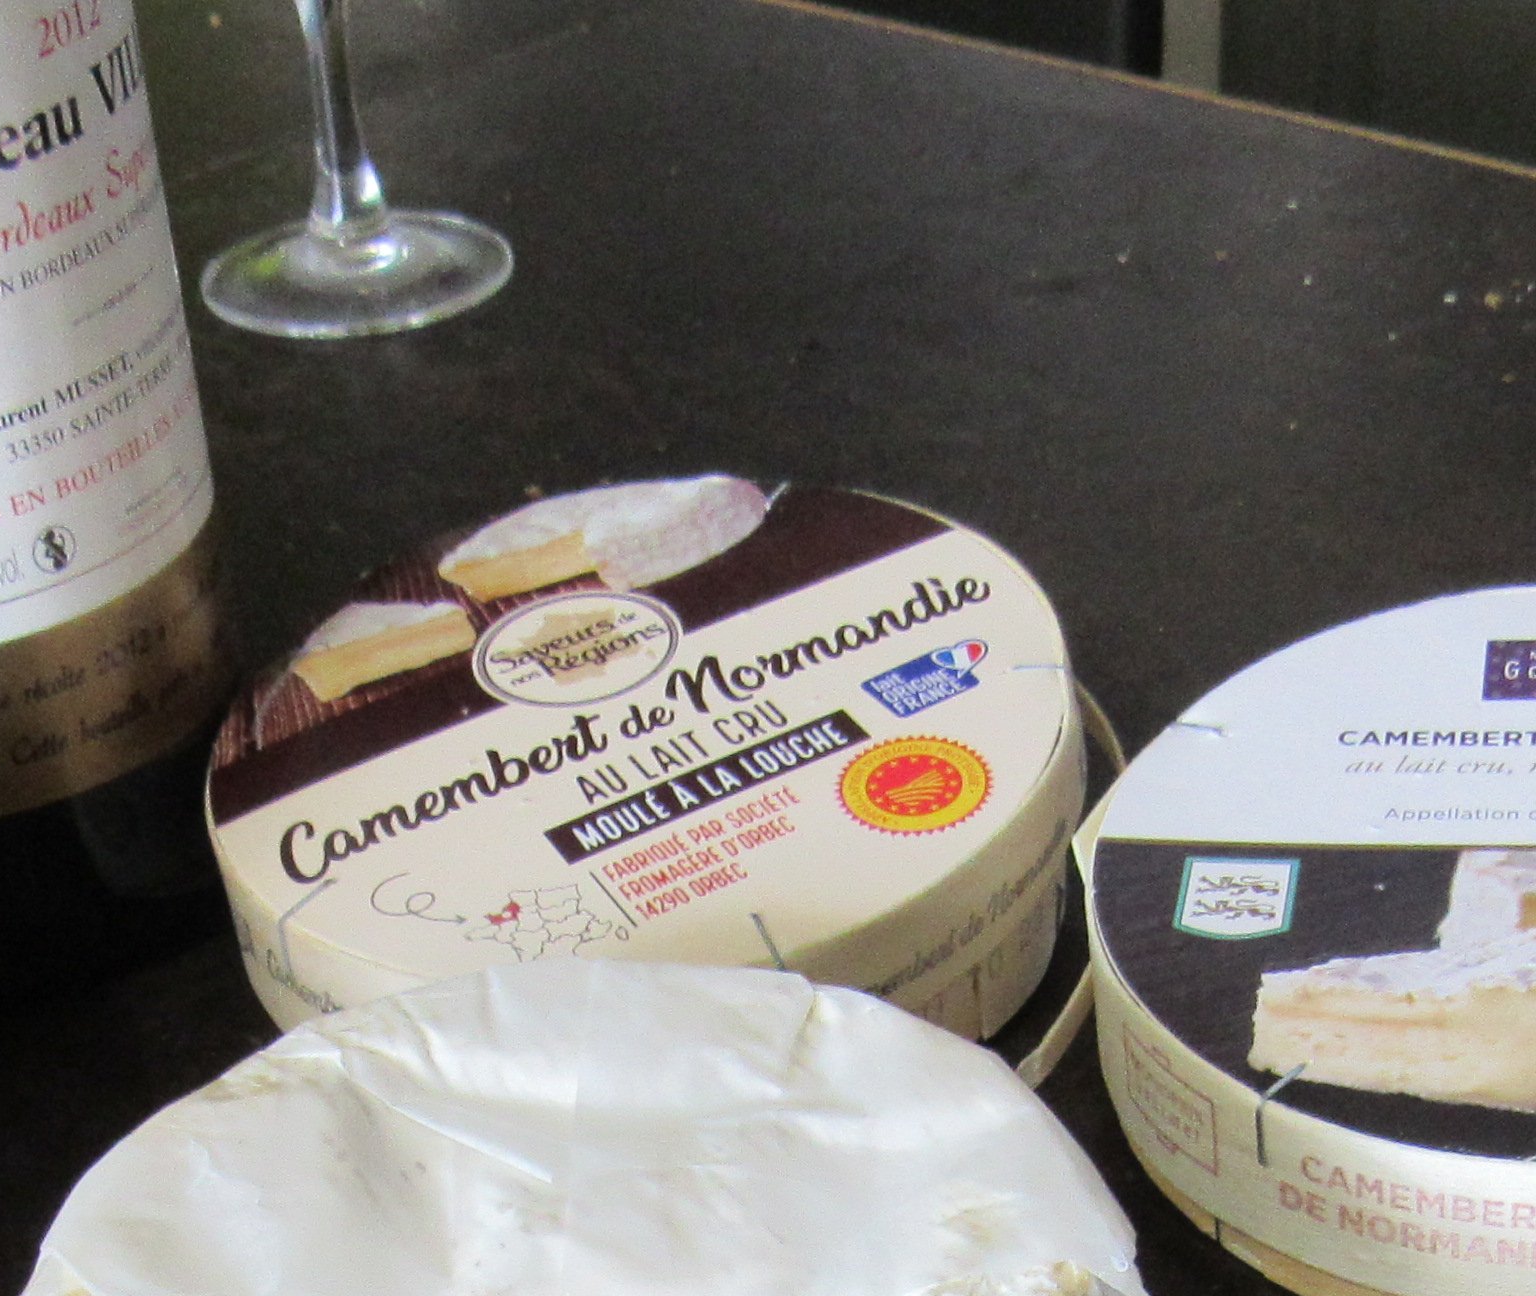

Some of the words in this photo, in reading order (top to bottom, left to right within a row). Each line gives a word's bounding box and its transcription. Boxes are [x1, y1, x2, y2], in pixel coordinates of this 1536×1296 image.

[6, 428, 64, 464] 33350
[9, 486, 46, 517] EN
[489, 618, 616, 674] Saveurs
[881, 669, 951, 703] ORIGINE
[892, 680, 966, 715] FRANCE
[278, 715, 610, 884] Camembert
[619, 704, 676, 740] de
[664, 574, 991, 714] Normandie
[575, 763, 629, 806] AU
[627, 730, 710, 775] LAIT
[712, 700, 789, 745] CRU
[1344, 759, 1384, 774] au
[1393, 754, 1449, 775] lait
[1456, 757, 1514, 777] cru,
[571, 791, 671, 852] MOULÉ
[667, 778, 701, 810] À
[696, 765, 743, 797] LA
[738, 720, 849, 780] LOUCHE
[601, 832, 688, 883] FABRIQUÉ
[687, 818, 726, 846] PAR
[725, 784, 802, 829] SOCIÉTÉ
[721, 815, 797, 857] D'ORBEC
[1383, 806, 1521, 824] Appellation
[635, 887, 692, 922] 14290
[688, 862, 750, 897] ORBEC
[1277, 1179, 1327, 1223] DE
